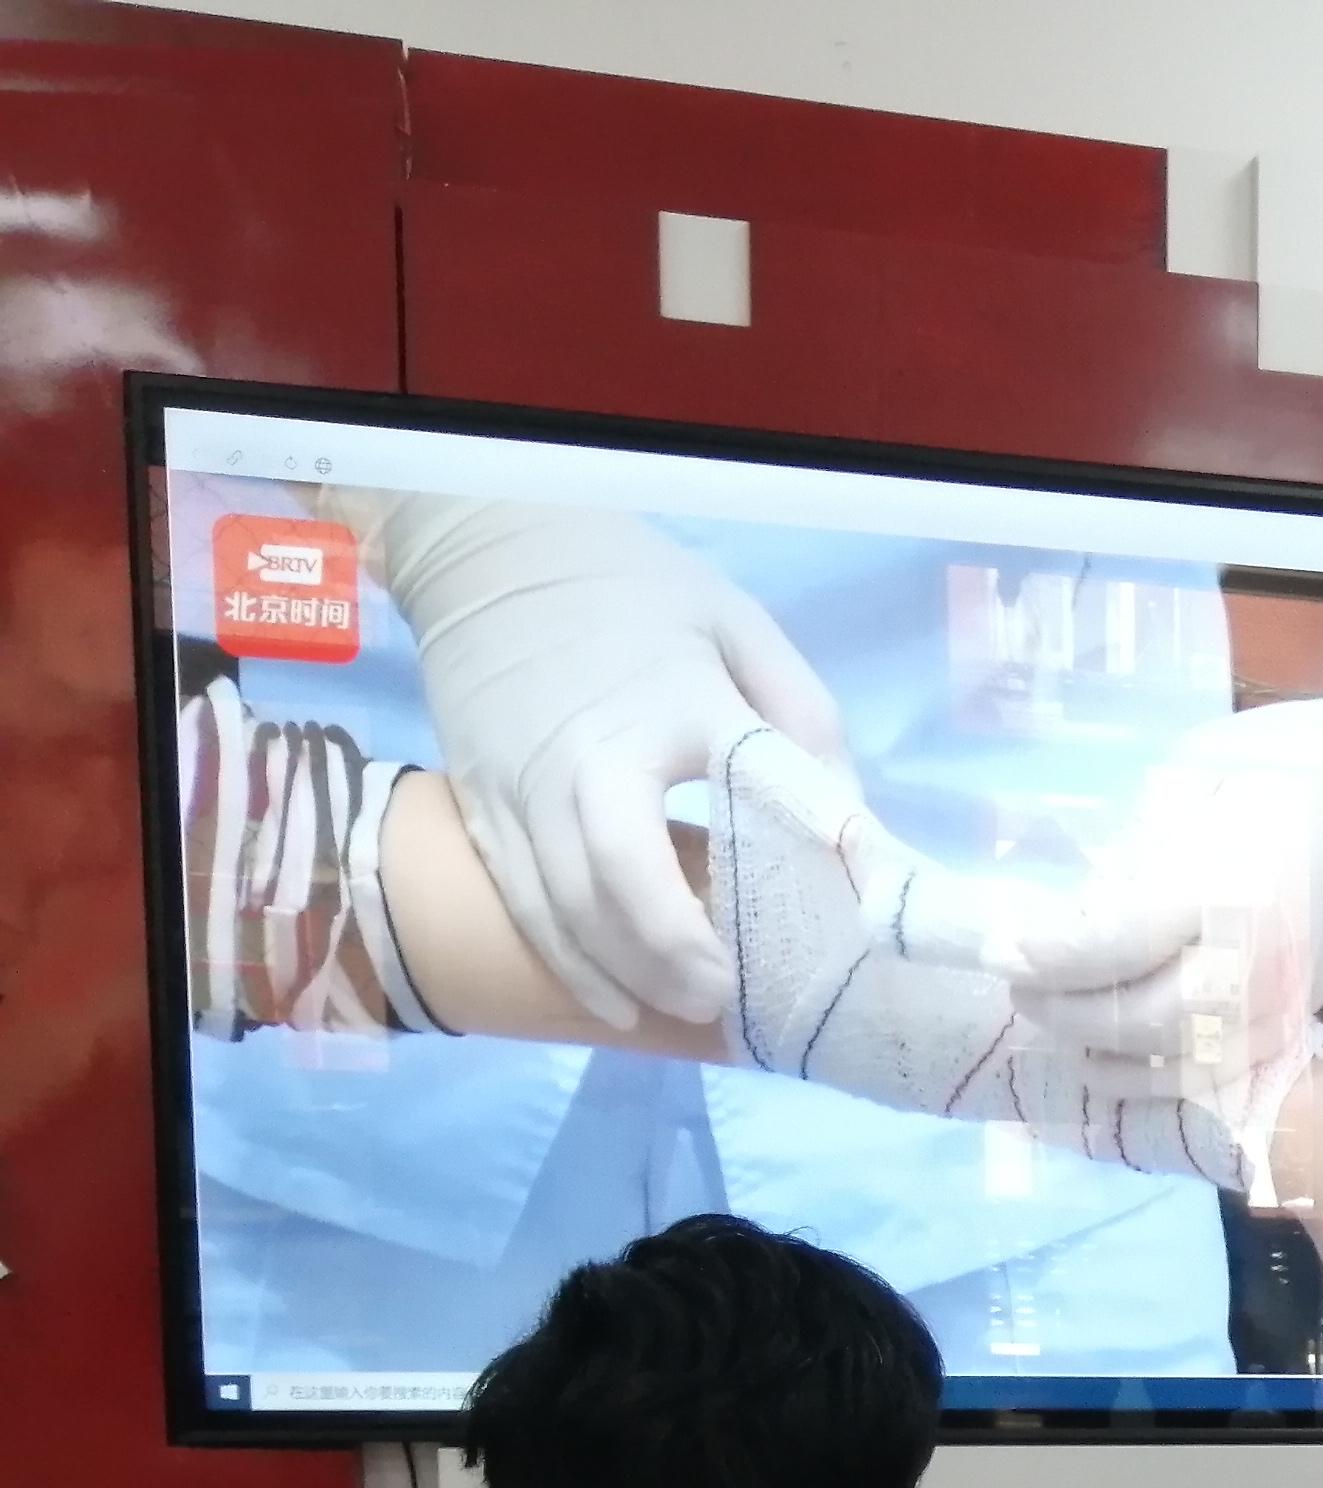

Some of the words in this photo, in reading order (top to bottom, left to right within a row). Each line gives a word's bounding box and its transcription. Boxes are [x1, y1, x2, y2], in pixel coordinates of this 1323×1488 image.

[267, 556, 318, 573] BRTV
[224, 591, 350, 630] 北京时间
